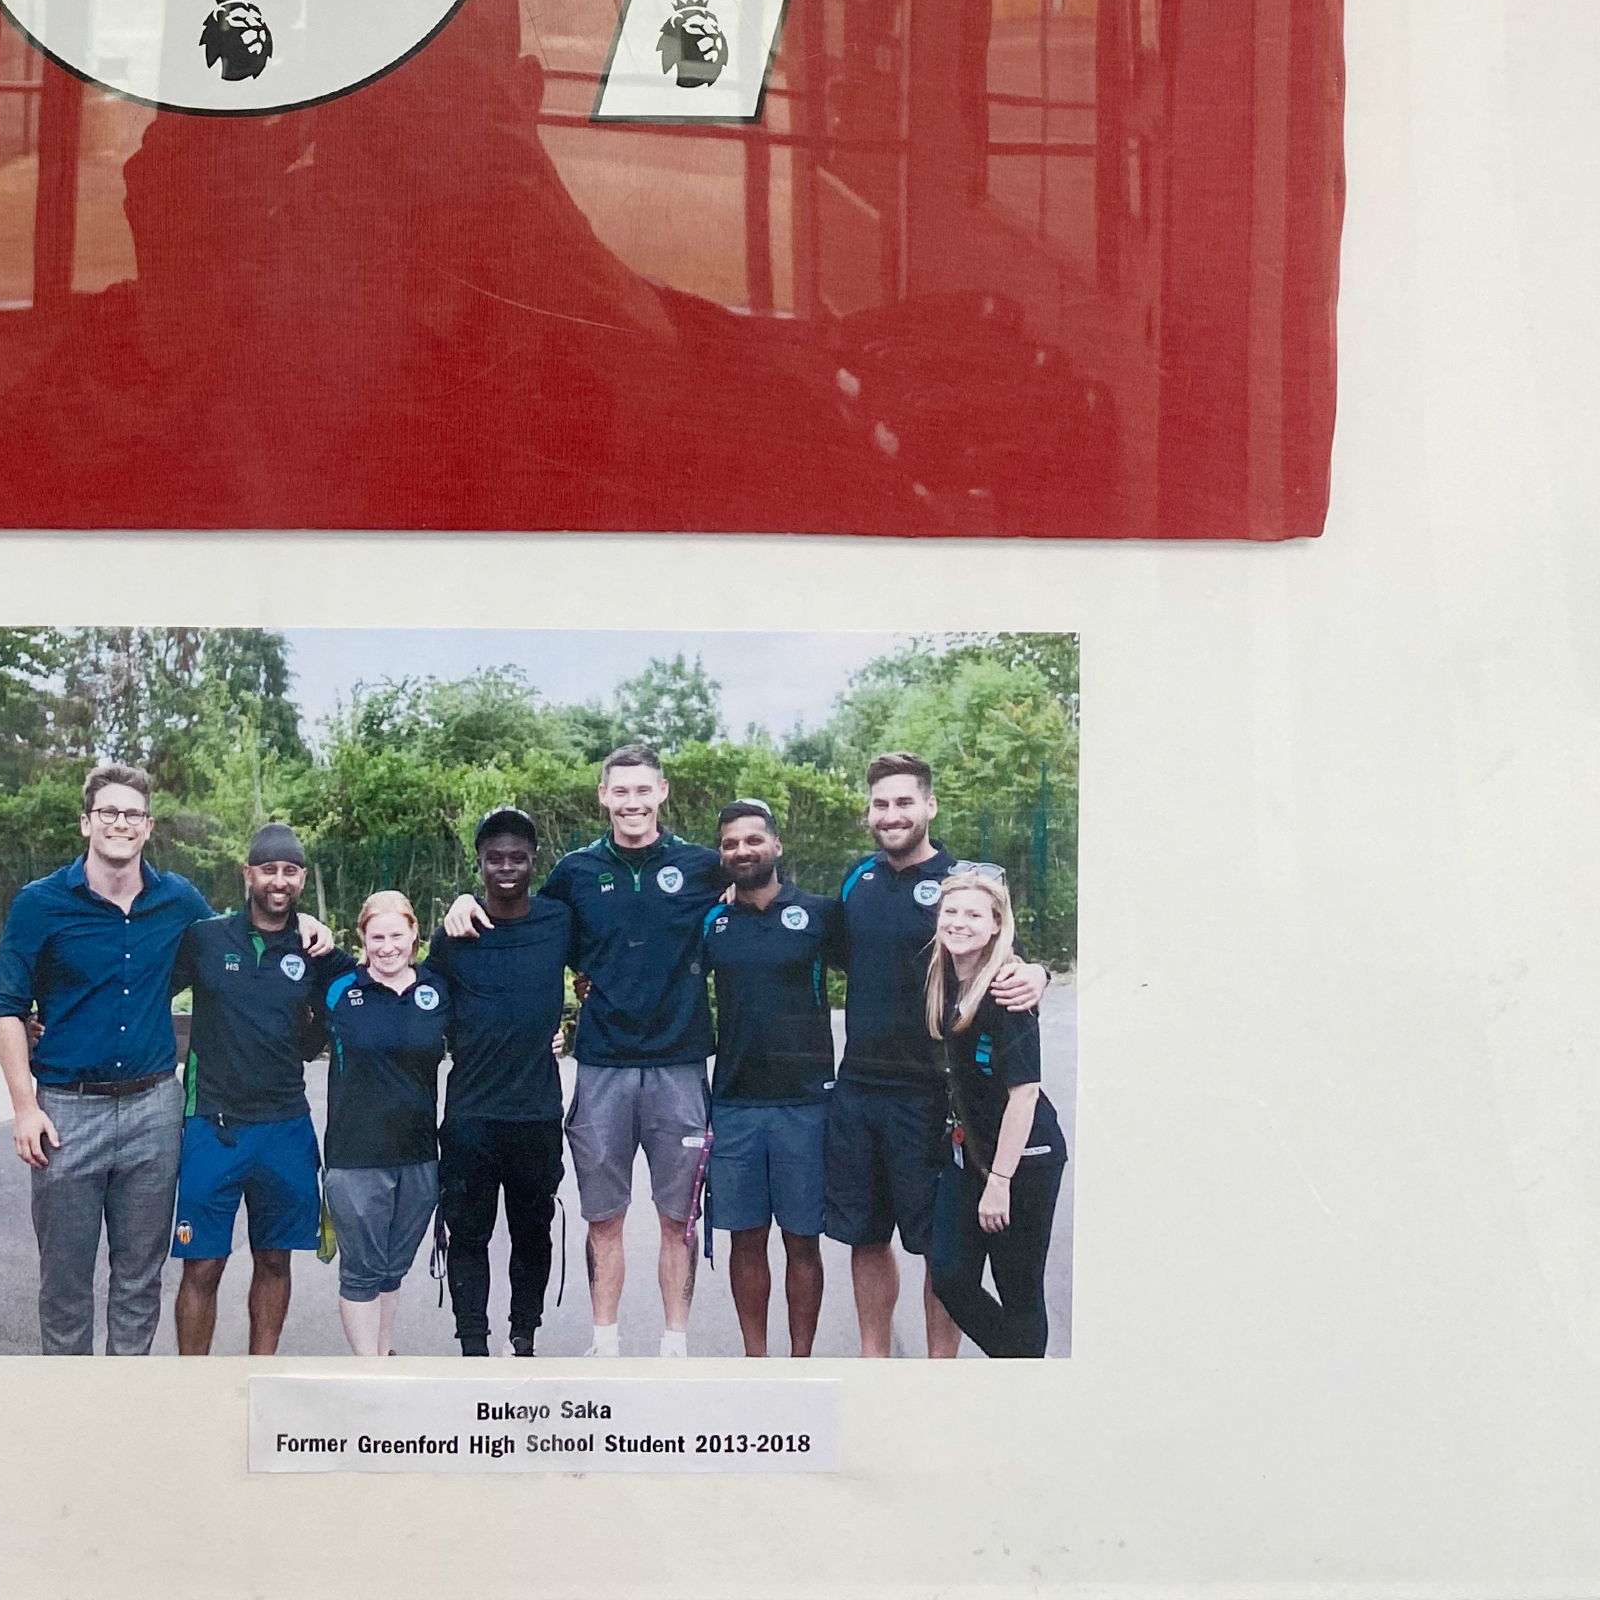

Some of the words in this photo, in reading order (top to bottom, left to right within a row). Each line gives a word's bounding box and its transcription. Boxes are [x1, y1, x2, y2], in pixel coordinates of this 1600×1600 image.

[225, 961, 240, 972] HS
[476, 1402, 551, 1424] Bukayo
[560, 1400, 612, 1420] Saka
[276, 1433, 348, 1453] Former
[357, 1434, 459, 1454] Greenford
[469, 1434, 515, 1459] High
[526, 1433, 594, 1453] School
[604, 1434, 686, 1454] Student
[695, 1434, 811, 1453] 2013-2018
